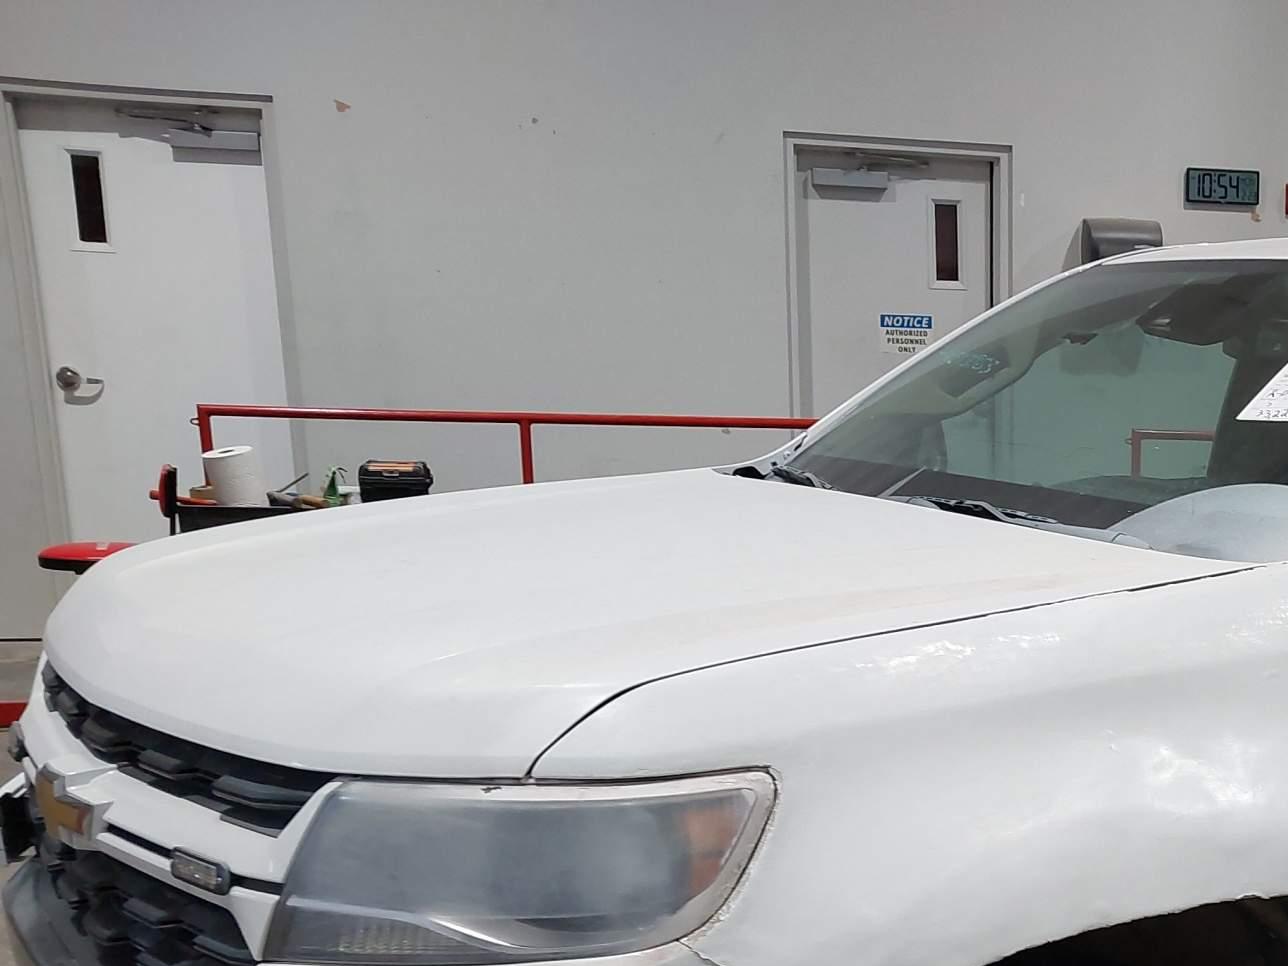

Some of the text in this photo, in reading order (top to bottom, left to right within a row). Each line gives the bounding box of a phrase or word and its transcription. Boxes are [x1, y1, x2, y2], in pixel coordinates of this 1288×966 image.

[1197, 172, 1240, 199] 10:54
[883, 316, 930, 328] NOTICE
[885, 329, 928, 337] AUTHORIZED
[886, 337, 927, 345] PERSONNEL
